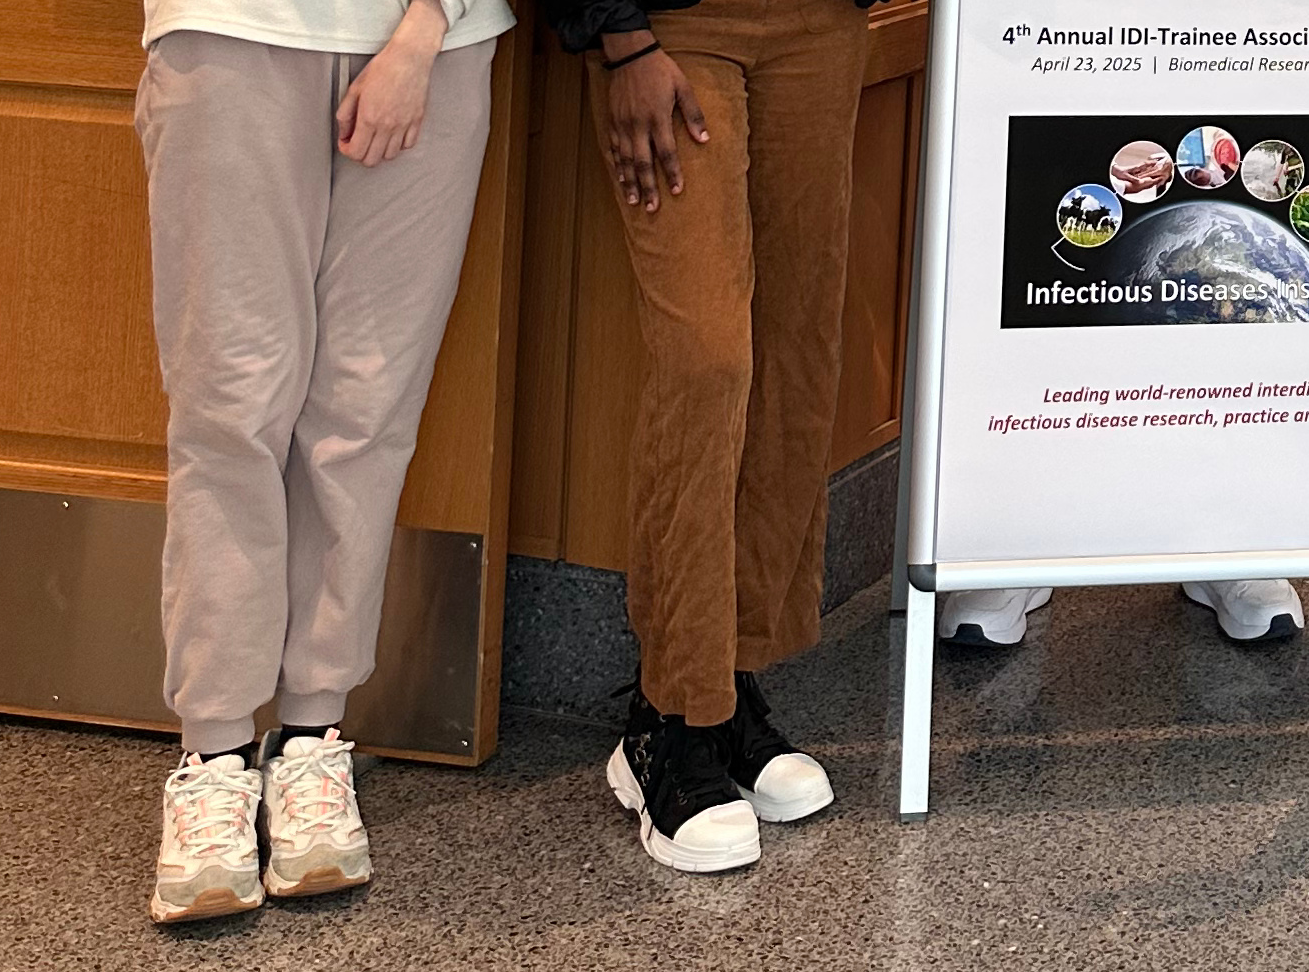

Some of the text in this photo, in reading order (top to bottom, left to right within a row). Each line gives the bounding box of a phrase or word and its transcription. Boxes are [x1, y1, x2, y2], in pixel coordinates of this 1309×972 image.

[1002, 24, 1031, 45] 4th
[1037, 26, 1113, 46] Annual
[1120, 27, 1237, 46] IDI-Trainee
[1031, 56, 1070, 74] April
[1074, 57, 1097, 73] 23,
[1103, 57, 1142, 71] 2025
[1168, 57, 1254, 71] Biomedical
[1027, 280, 1153, 305] Infectious
[1161, 279, 1268, 302] Diseases
[1044, 387, 1110, 405] Leading
[1115, 383, 1253, 401] world-renowned
[988, 414, 1071, 434] infectious
[1076, 413, 1138, 429] disease
[1143, 409, 1218, 427] research,
[1223, 408, 1290, 428] practice
